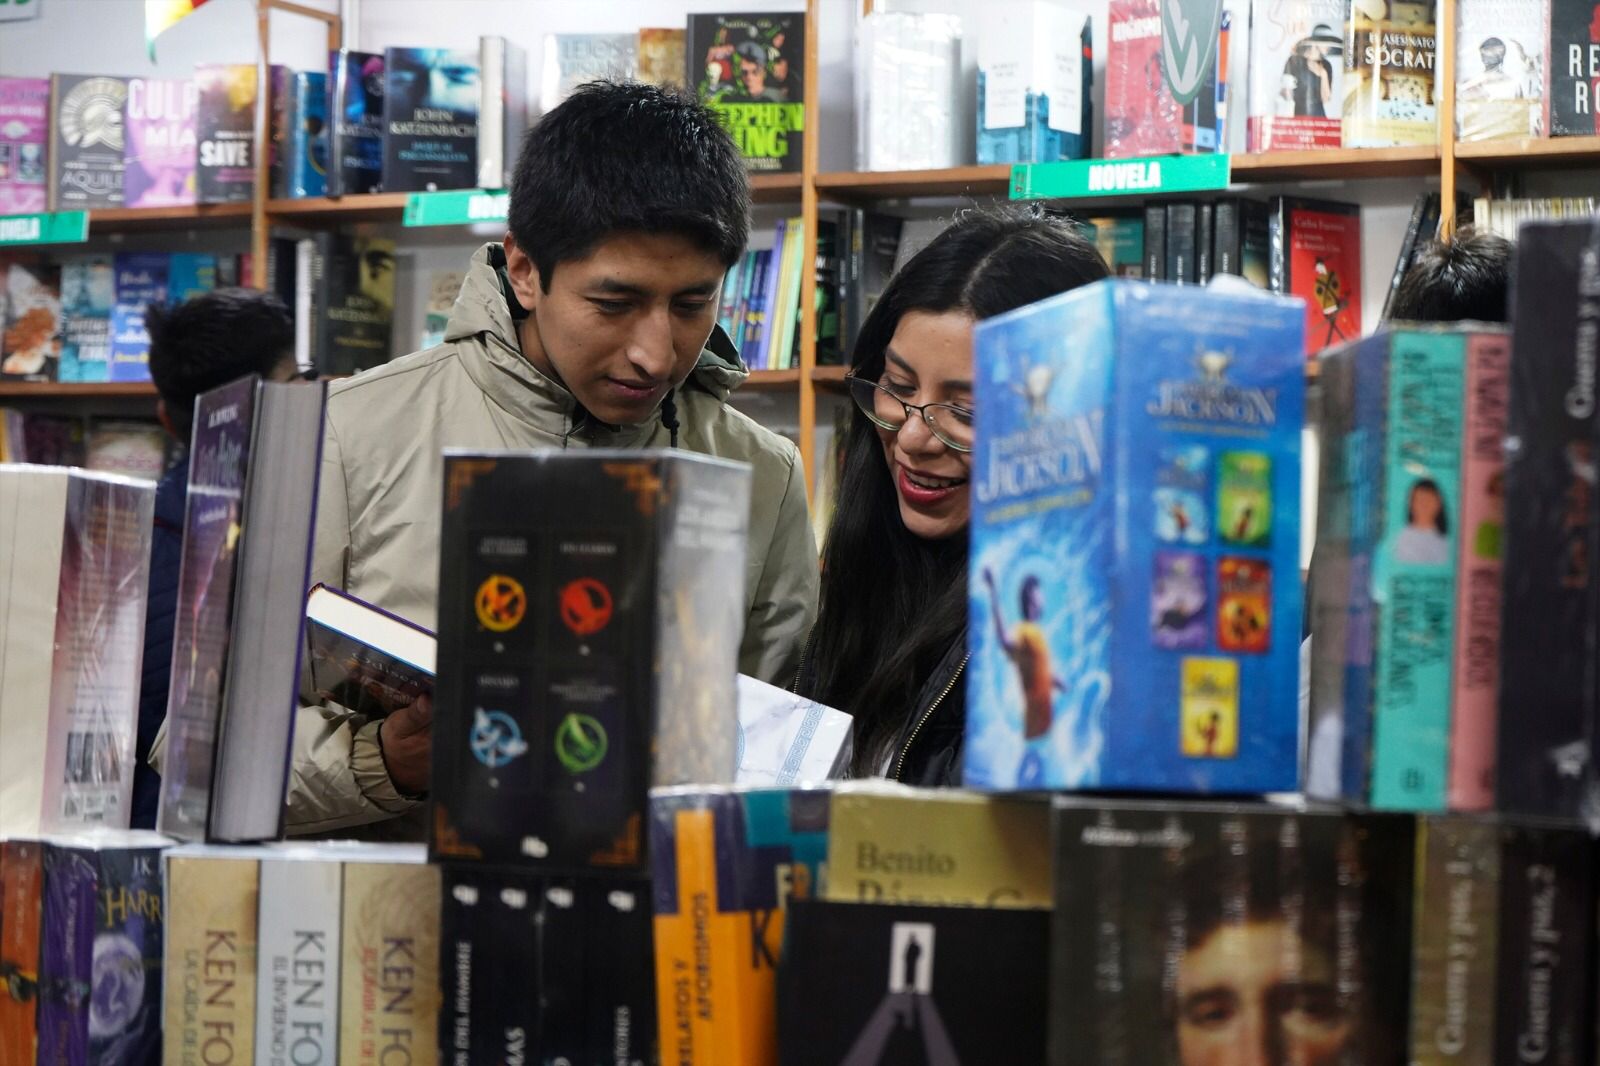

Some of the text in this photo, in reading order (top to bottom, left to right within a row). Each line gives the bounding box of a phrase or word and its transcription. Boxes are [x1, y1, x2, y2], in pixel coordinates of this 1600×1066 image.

[200, 140, 248, 167] SAVE
[1088, 162, 1161, 191] NOVELA
[856, 840, 956, 876] Benito
[204, 929, 237, 1009] KEN
[293, 930, 326, 1008] KEN
[381, 936, 415, 1016] KEN
